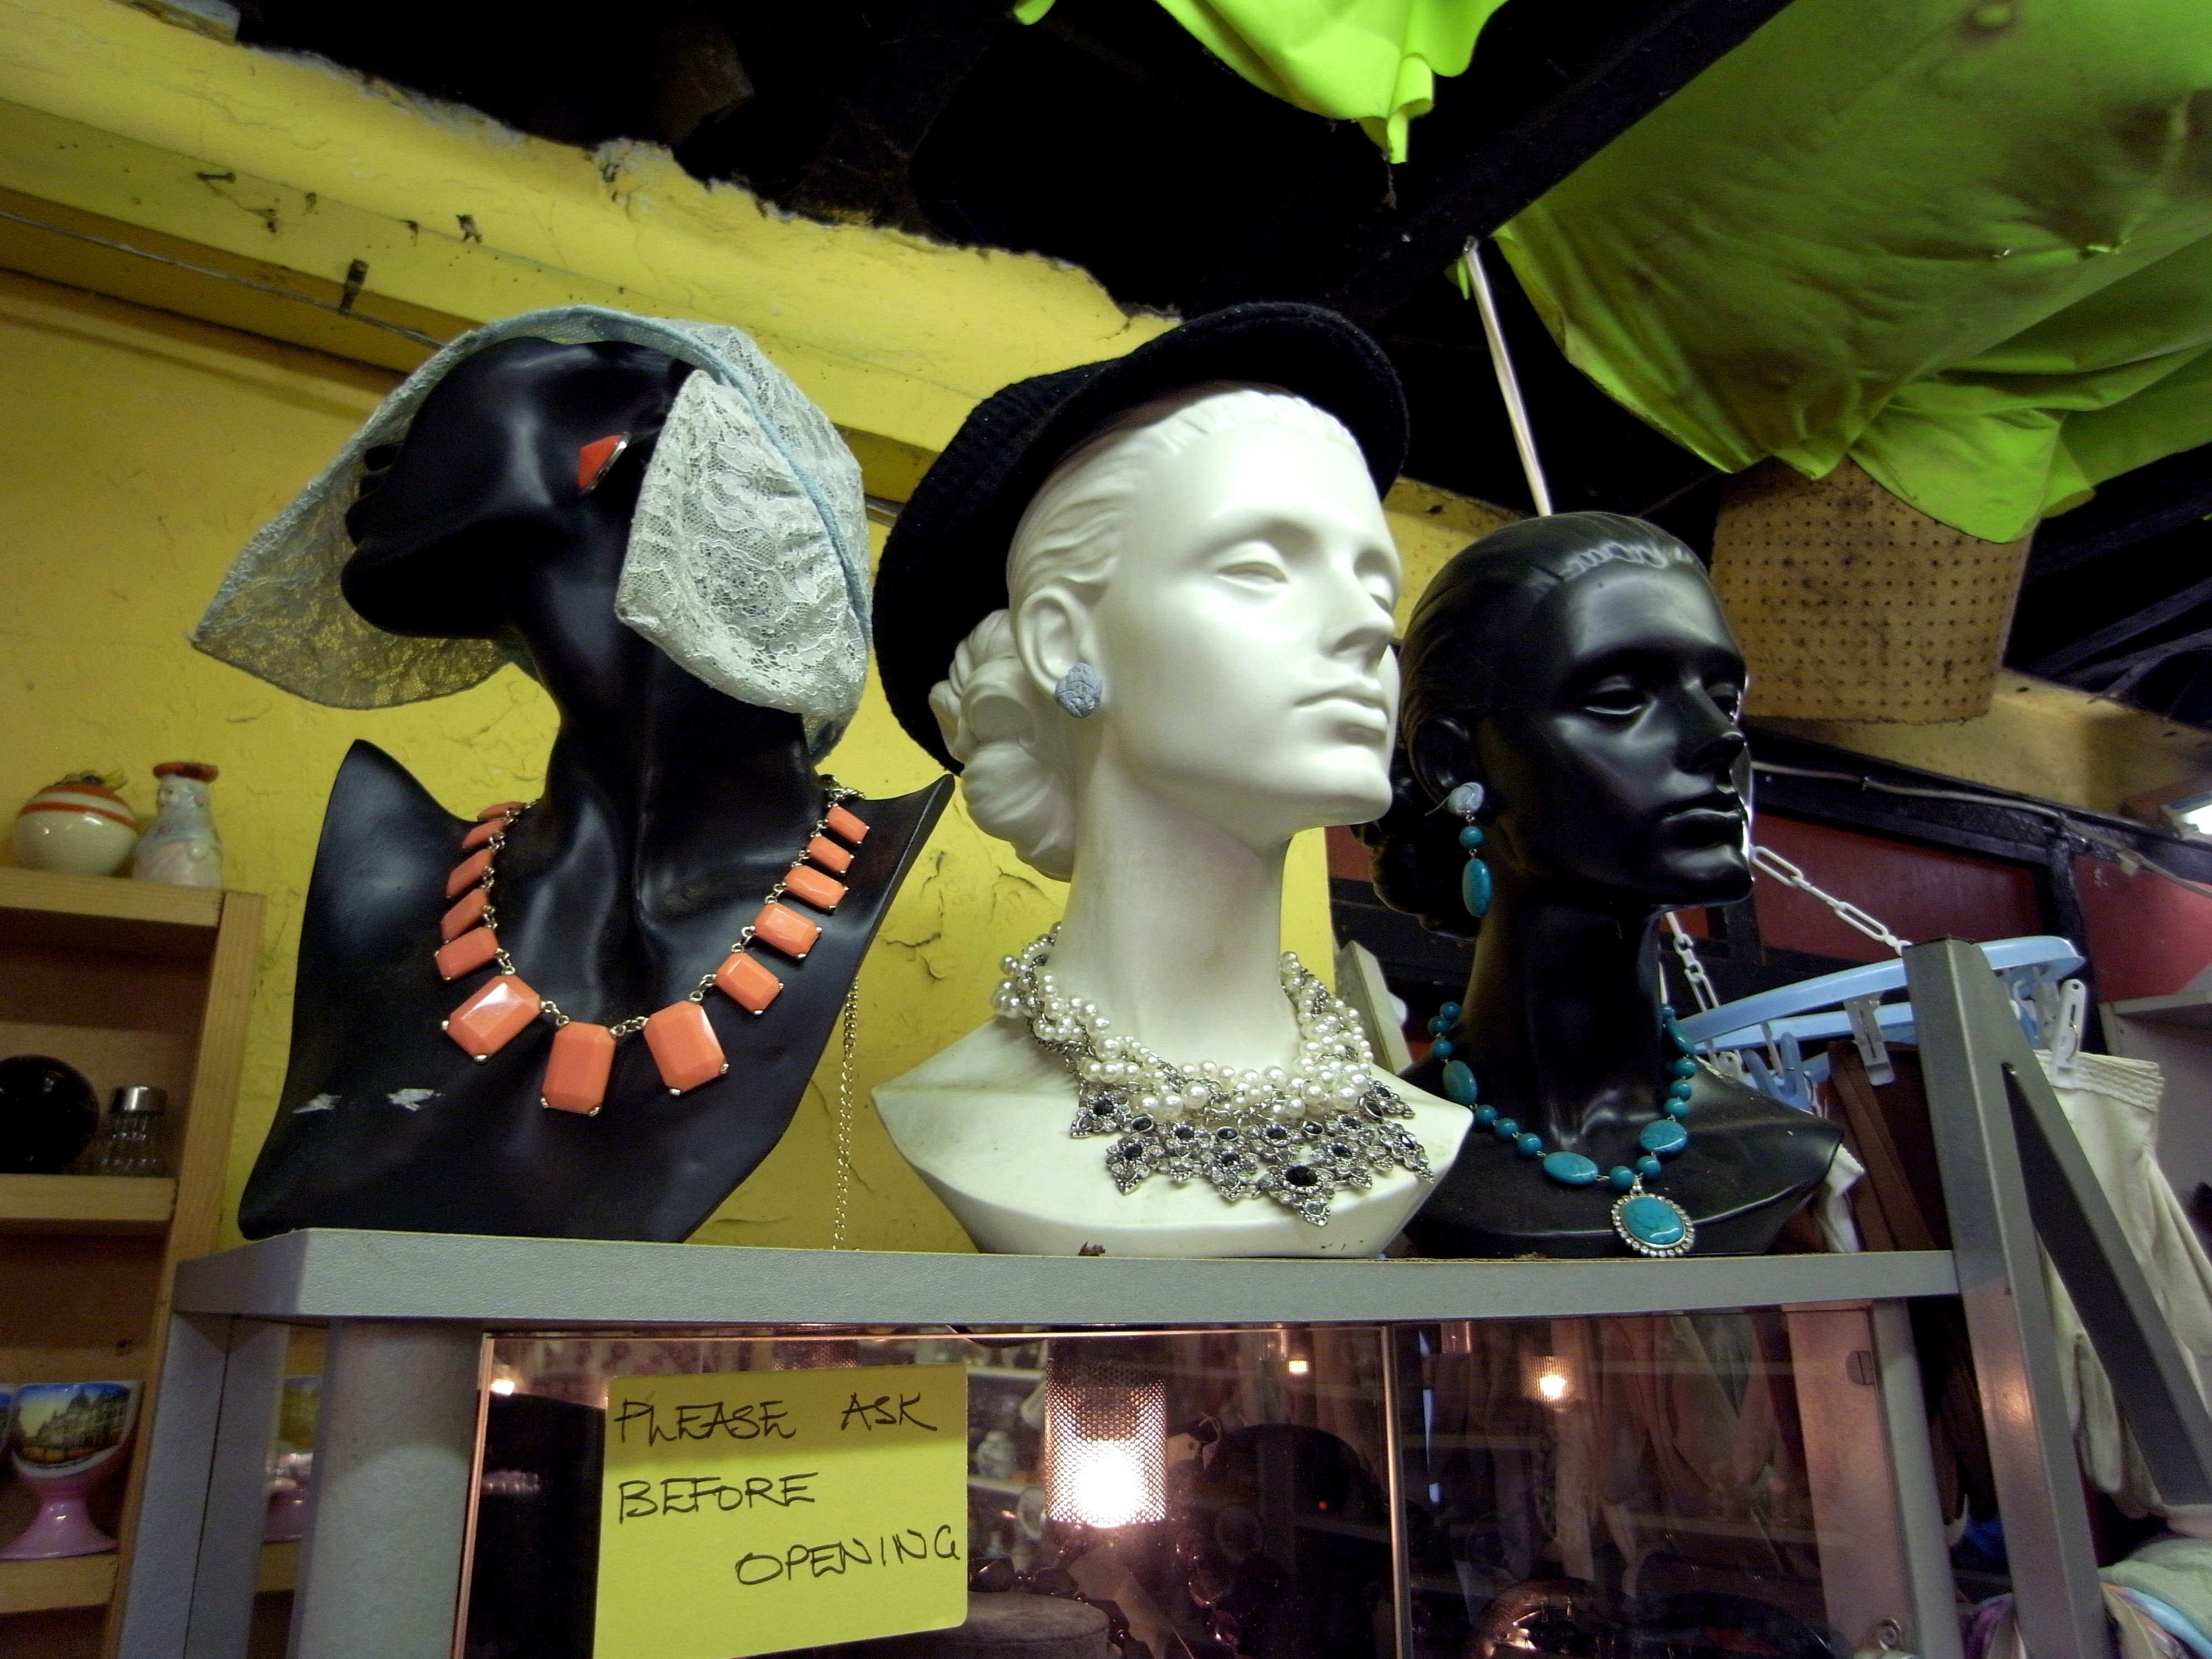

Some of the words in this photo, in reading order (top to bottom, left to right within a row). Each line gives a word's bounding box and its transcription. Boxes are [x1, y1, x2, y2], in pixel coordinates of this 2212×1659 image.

[615, 1400, 796, 1447] PLEASE
[841, 1392, 938, 1431] ASK
[619, 1472, 819, 1524] BEFORE
[735, 1524, 961, 1585] OPENING
